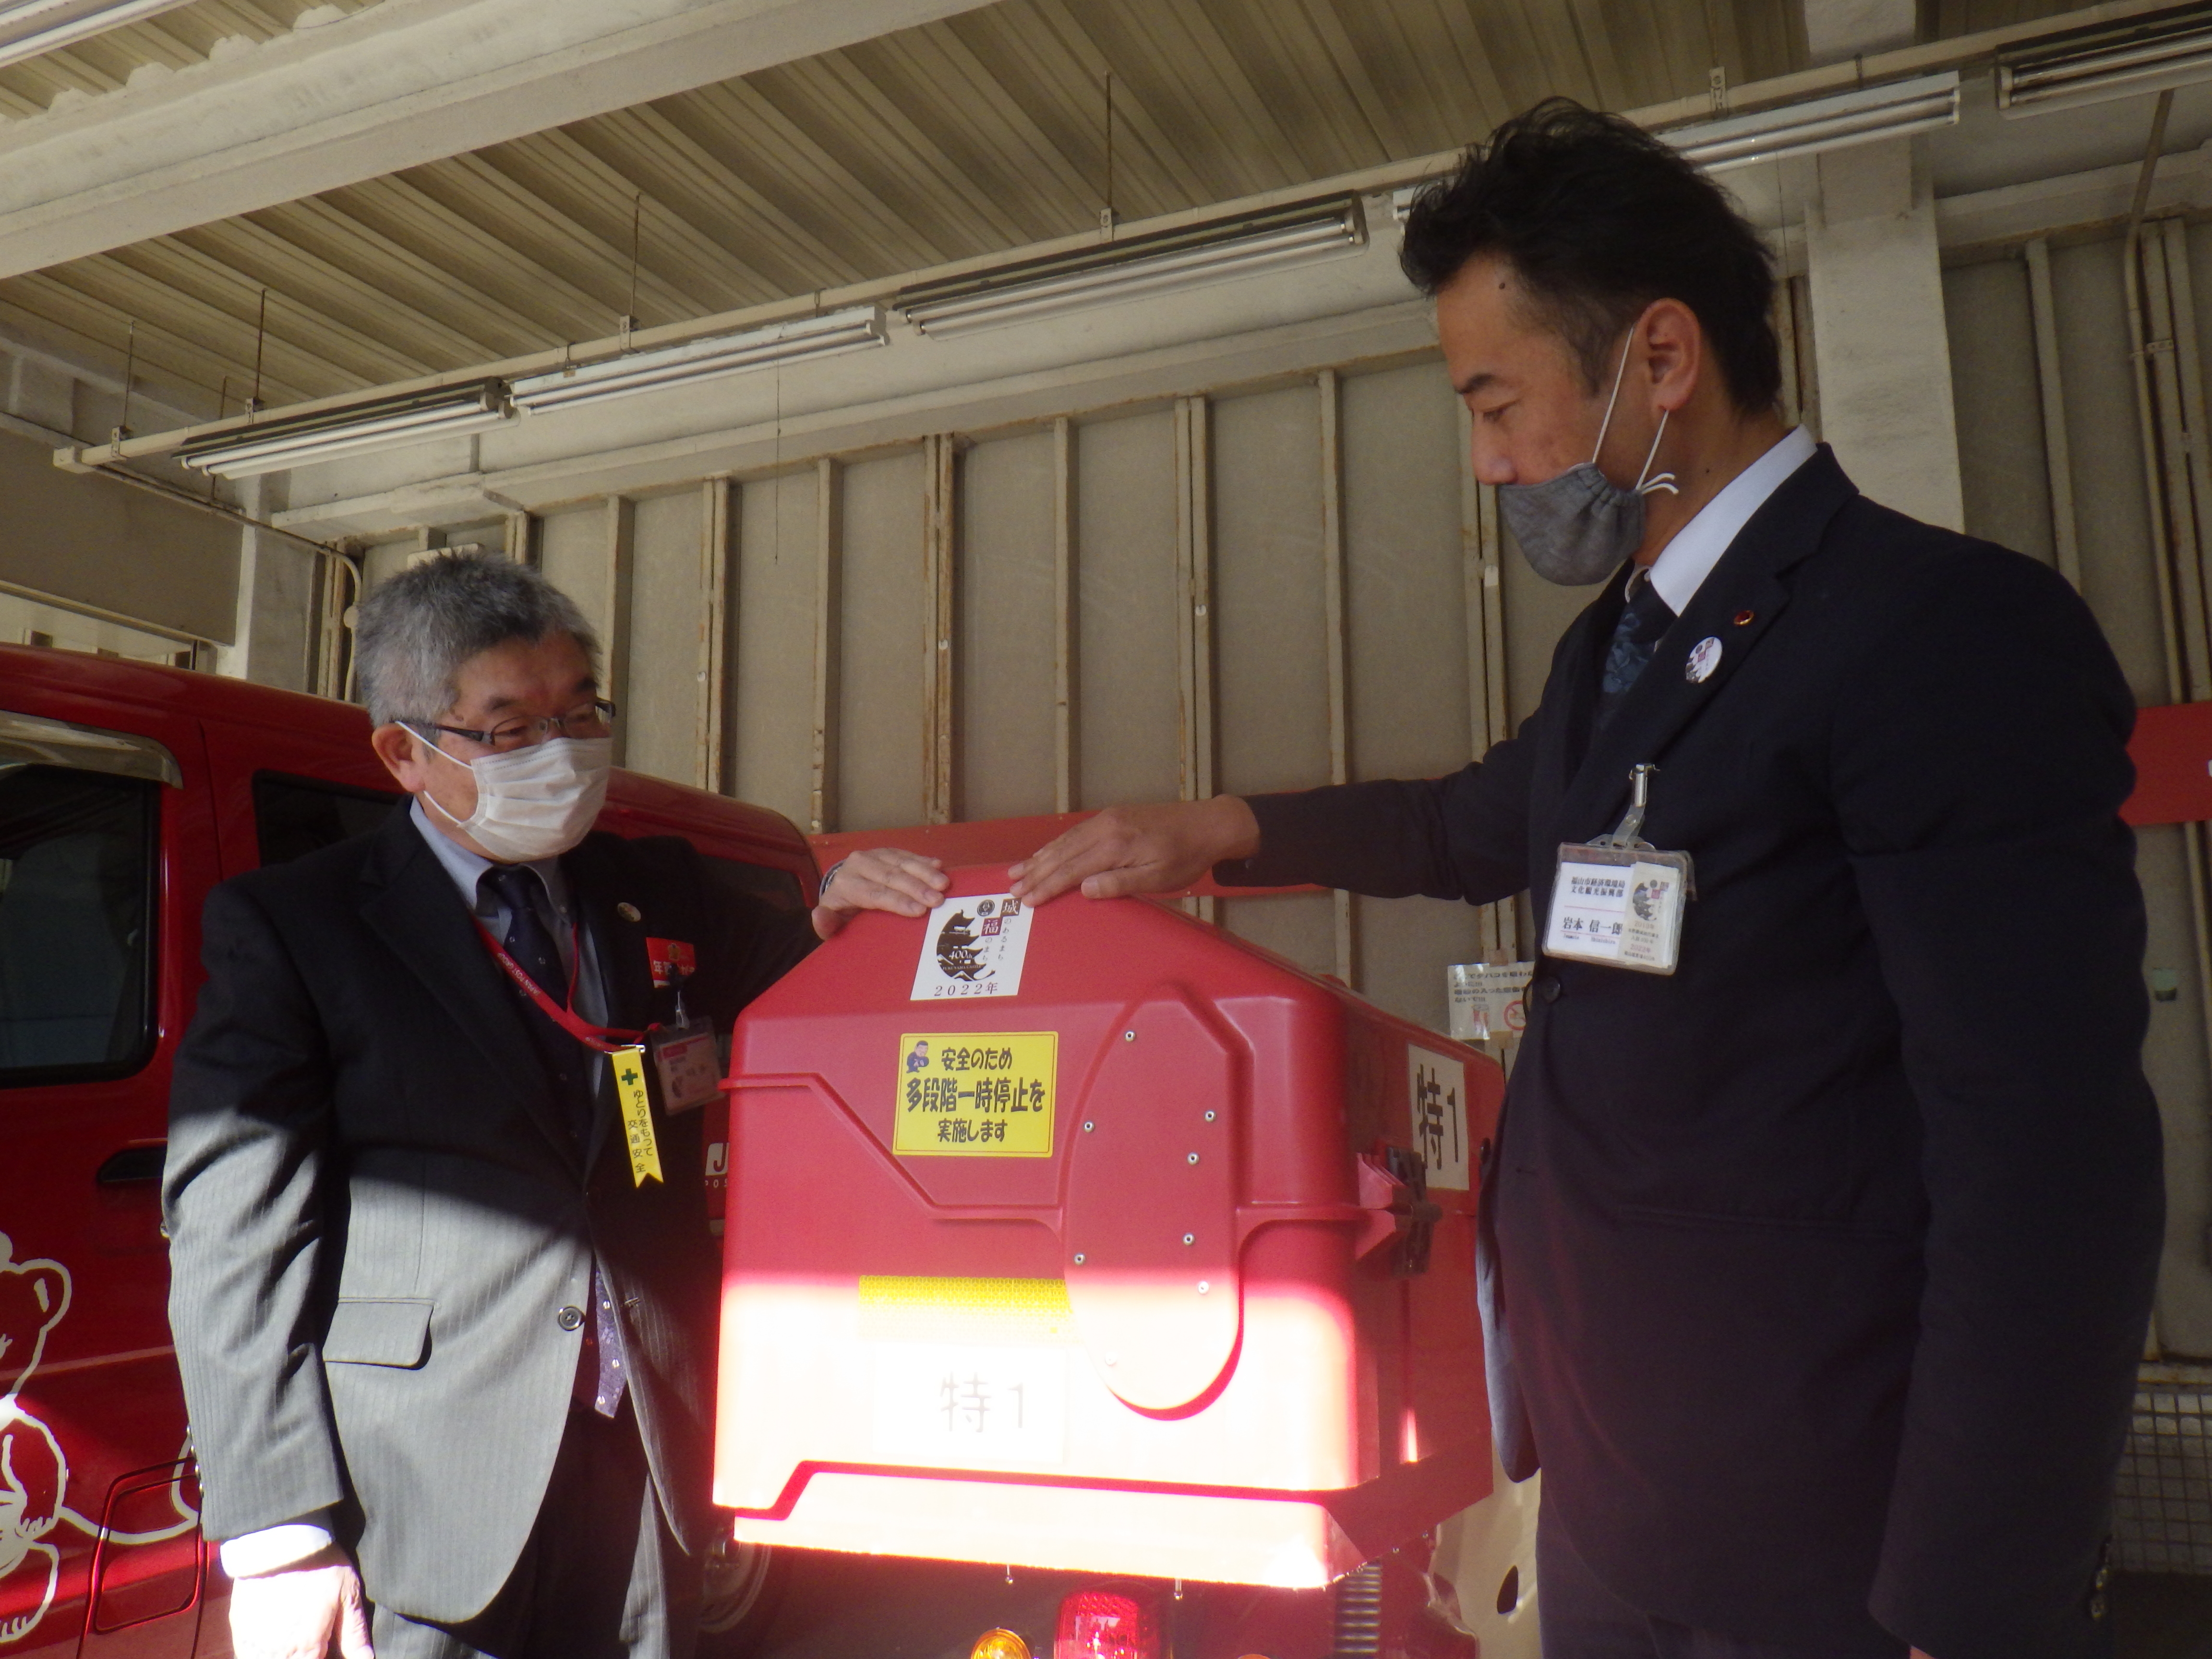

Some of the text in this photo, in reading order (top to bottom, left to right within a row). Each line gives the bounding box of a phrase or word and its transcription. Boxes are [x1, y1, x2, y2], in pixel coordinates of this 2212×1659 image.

[934, 982, 998, 997] 2022年
[941, 1047, 1012, 1071] 安全のため
[906, 1077, 1046, 1113] 多段階一時停止を
[634, 1090, 653, 1156] ゆとりをもって
[938, 1118, 1008, 1142] 実施します
[628, 1120, 646, 1173] 交通安全
